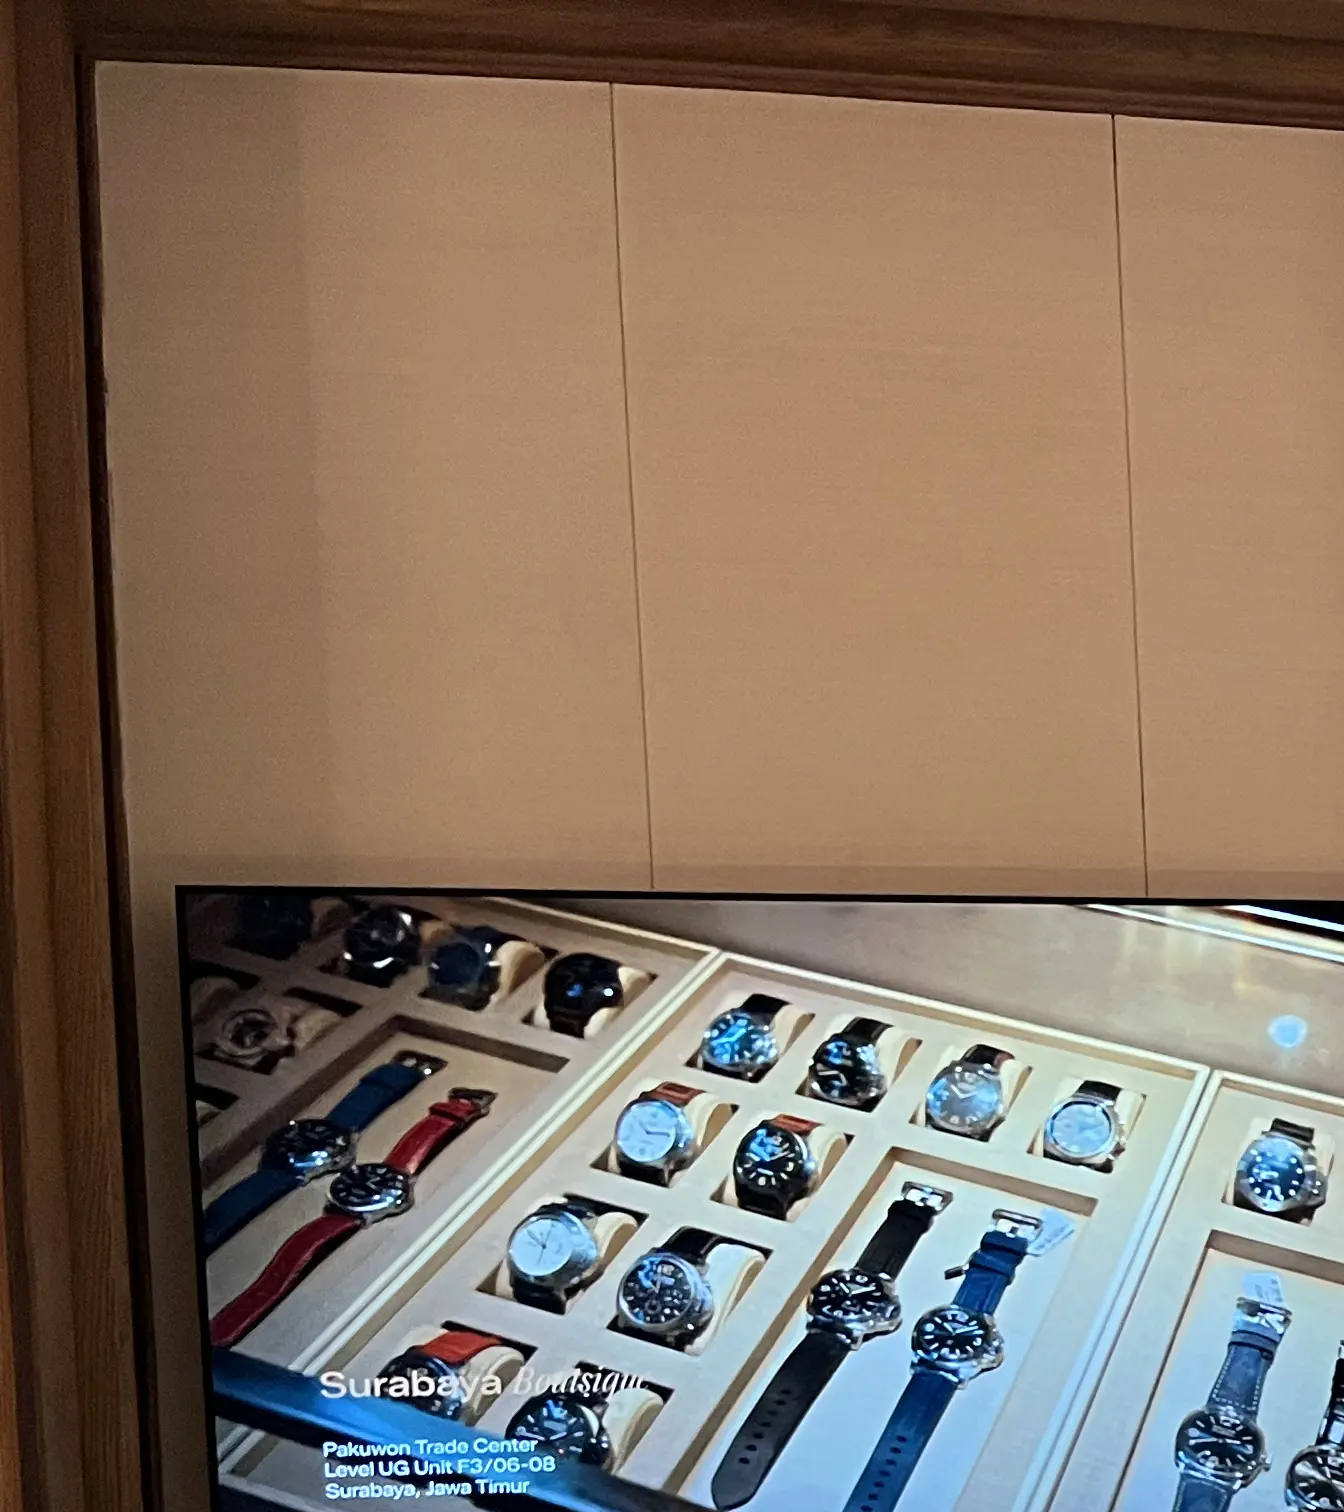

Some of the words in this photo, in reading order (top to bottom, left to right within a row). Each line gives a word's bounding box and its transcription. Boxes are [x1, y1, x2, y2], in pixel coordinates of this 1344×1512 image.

[320, 1369, 502, 1402] Surabaya
[322, 1441, 411, 1458] Pakuwon
[415, 1439, 469, 1455] Trade
[473, 1437, 538, 1453] Center
[324, 1461, 375, 1478] Level
[378, 1460, 410, 1477] UG
[414, 1459, 453, 1475] Unit
[457, 1456, 556, 1474] F3/06-08
[325, 1482, 421, 1500] Surabaya,
[425, 1480, 472, 1496] Jawa
[475, 1479, 531, 1494] Timur
